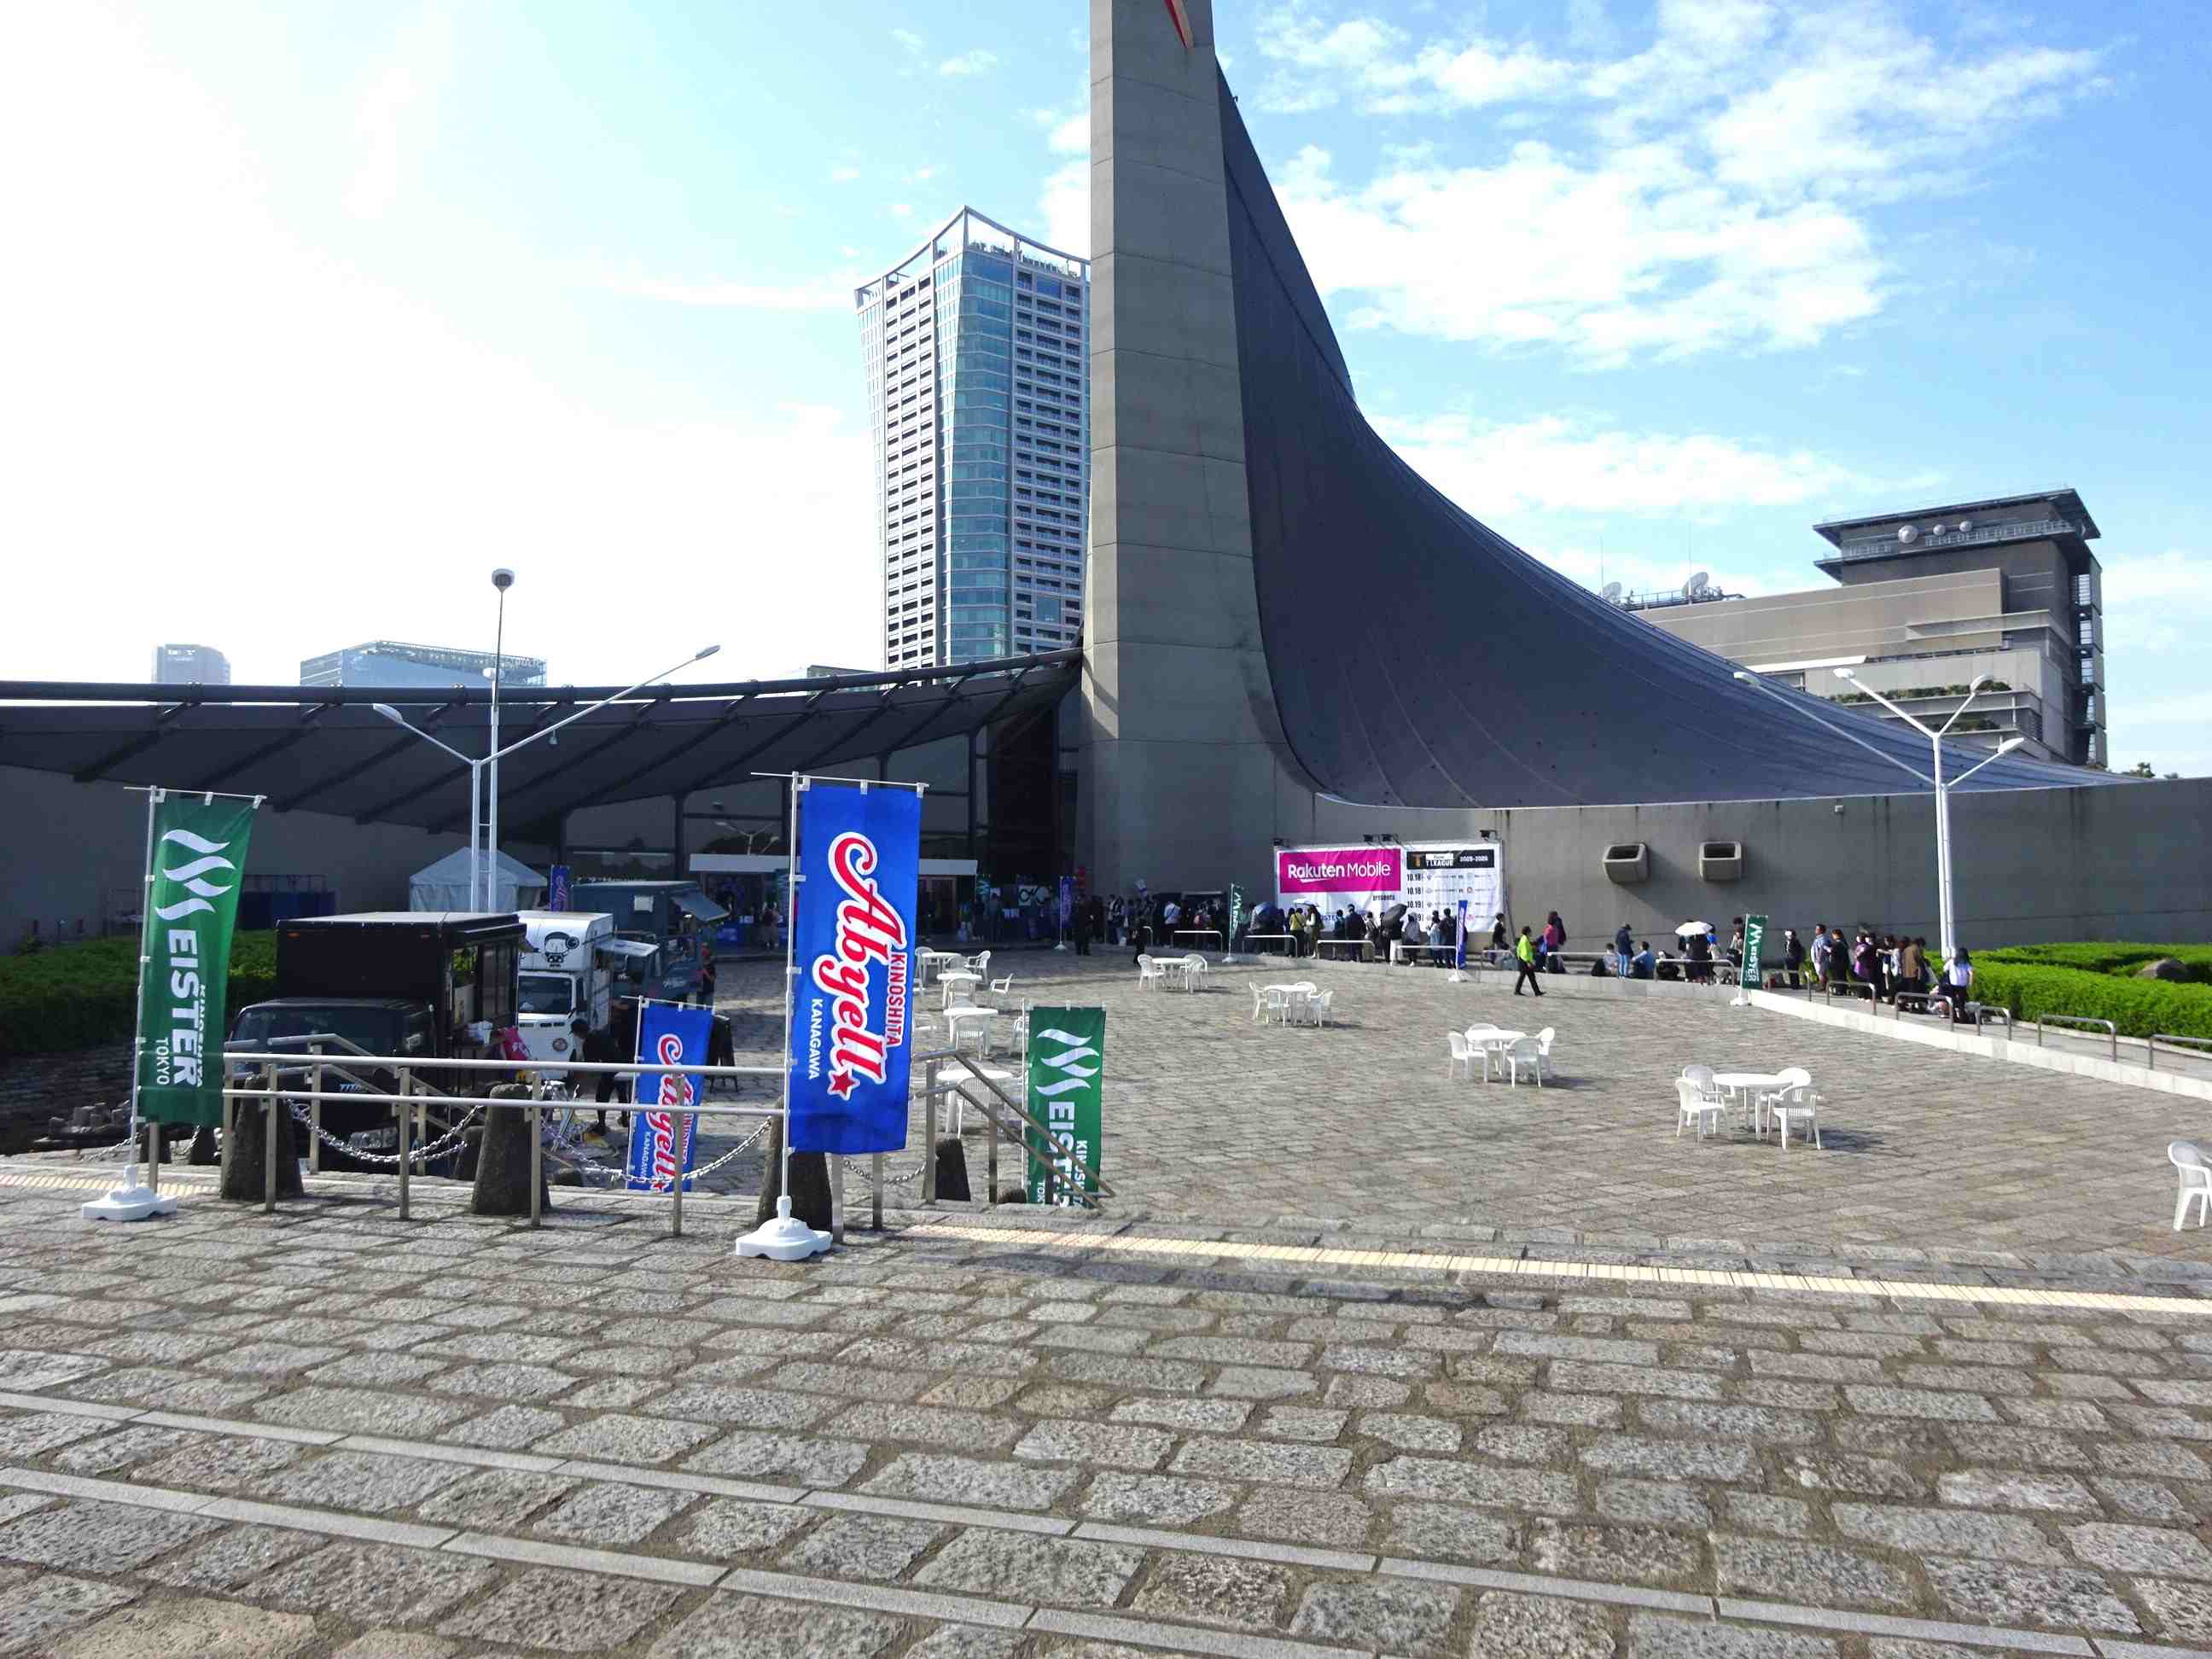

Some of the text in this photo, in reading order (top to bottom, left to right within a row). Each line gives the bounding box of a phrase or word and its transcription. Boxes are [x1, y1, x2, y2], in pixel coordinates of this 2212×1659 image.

[1288, 861, 1391, 879] Rakuten Mobile
[812, 832, 907, 1084] Abyell
[808, 998, 822, 1080] KANAGAWA
[885, 952, 905, 1047] KINOSHITA
[154, 1036, 171, 1086] TOKYO
